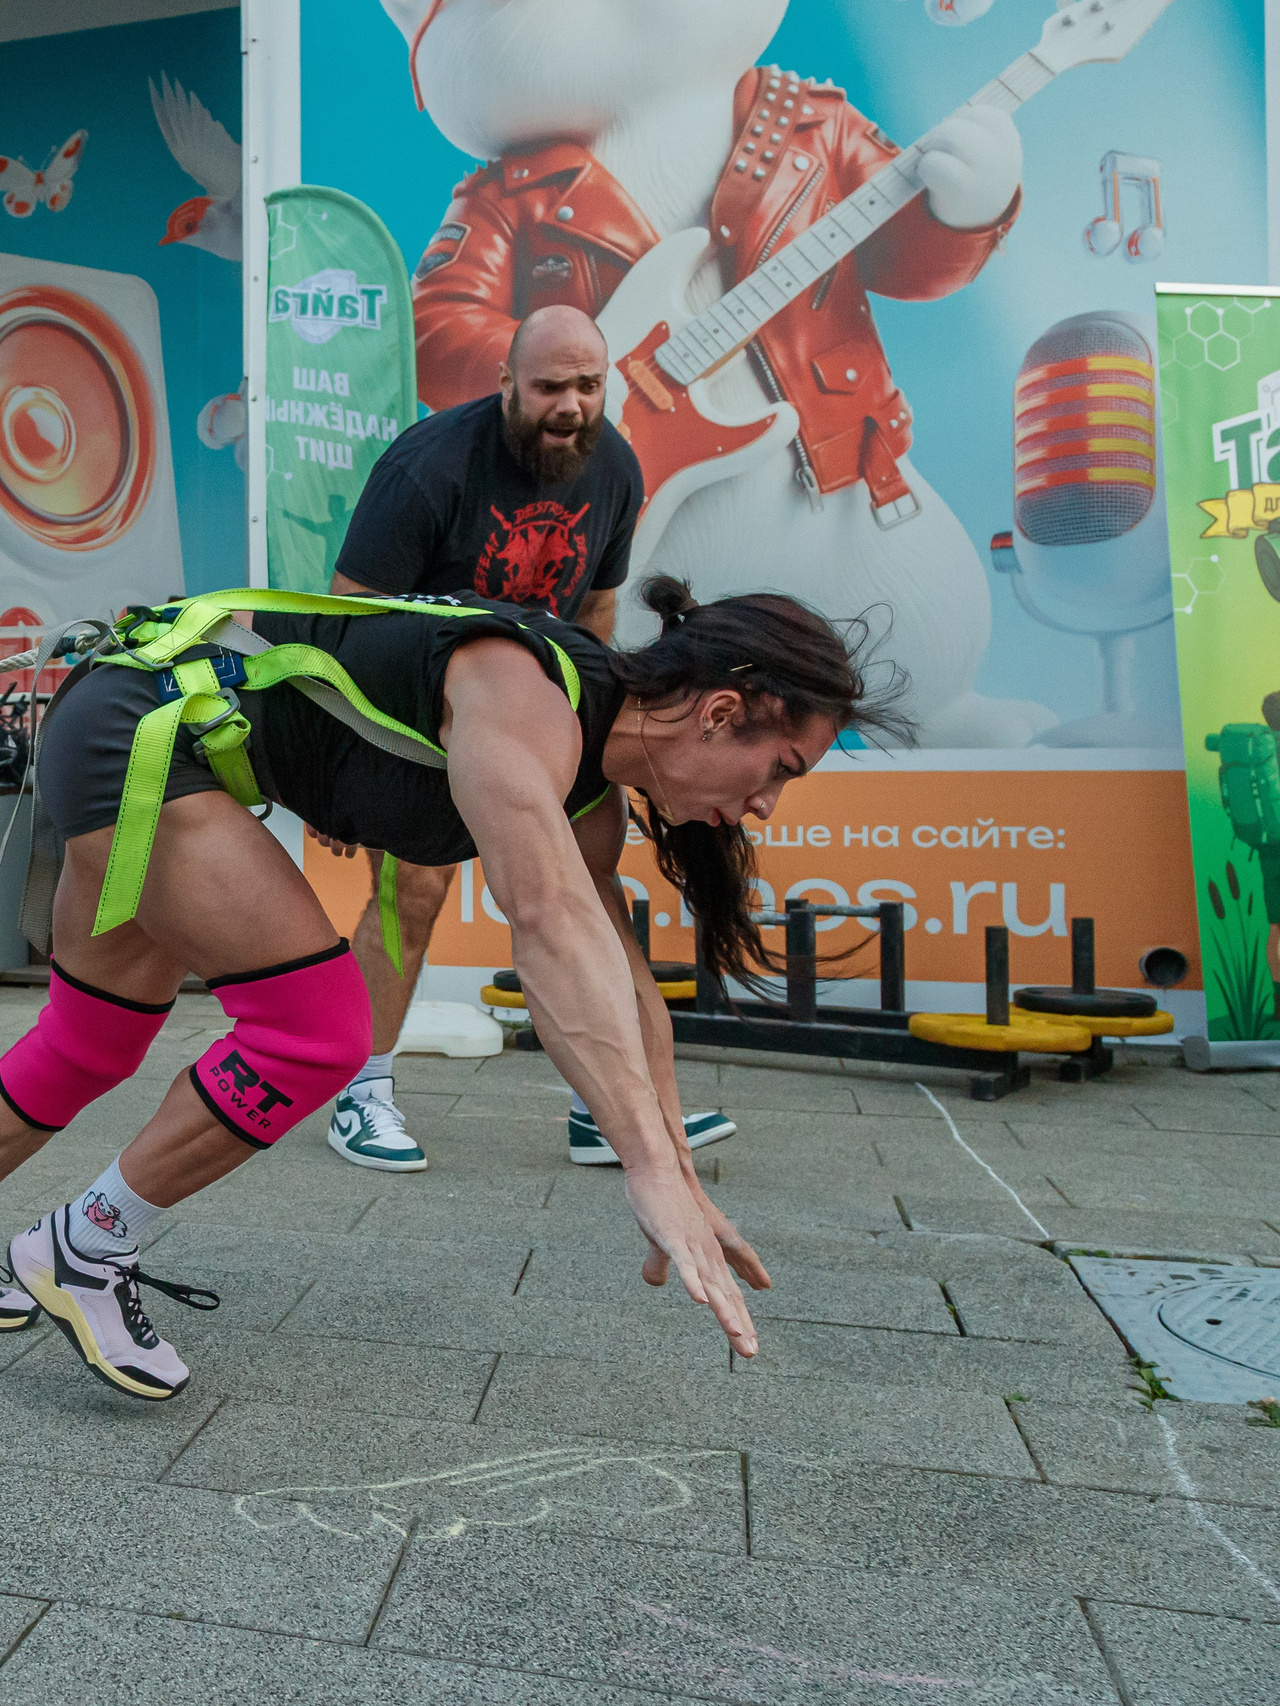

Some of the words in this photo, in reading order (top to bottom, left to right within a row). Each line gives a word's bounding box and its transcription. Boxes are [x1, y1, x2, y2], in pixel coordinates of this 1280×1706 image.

[843, 825, 899, 848] на
[912, 818, 1066, 849] сайте:
[209, 1065, 272, 1130] POWER
[219, 1049, 294, 1114] RT
